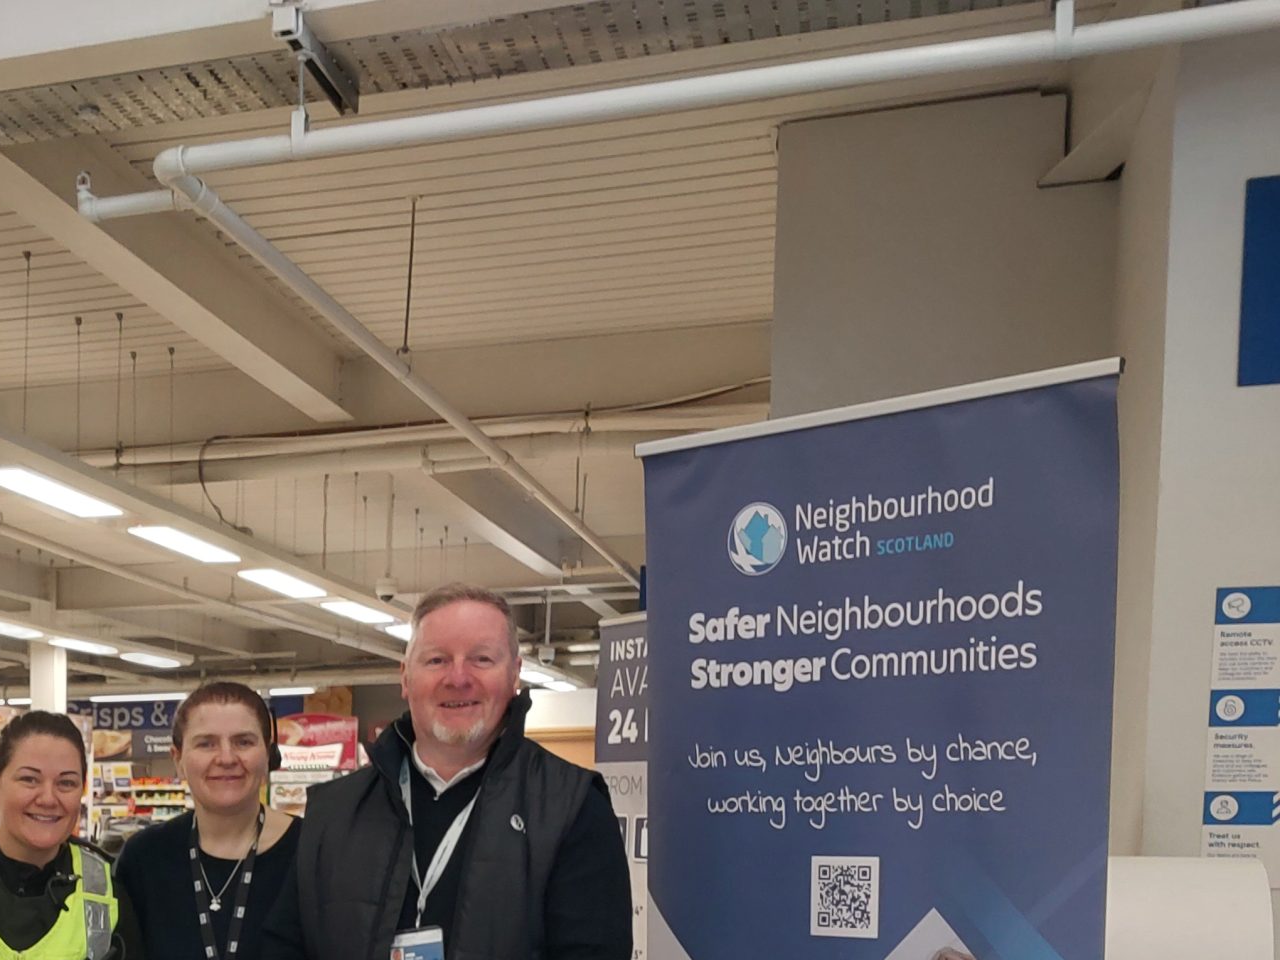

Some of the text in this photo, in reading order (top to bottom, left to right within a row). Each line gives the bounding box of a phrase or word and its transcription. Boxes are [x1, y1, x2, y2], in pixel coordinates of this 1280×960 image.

[795, 477, 995, 531] Neighbourhood
[797, 531, 954, 565] Watch SCOTLAND
[688, 580, 1043, 644] Safer Neighbourhoods
[690, 636, 1037, 692] Stronger Communities
[150, 701, 169, 727] &
[607, 708, 639, 745] 24
[688, 744, 727, 769] Join
[734, 749, 767, 772] us,
[906, 737, 937, 779] by
[946, 733, 1038, 767] chance,
[707, 785, 1007, 830] working together by choice
